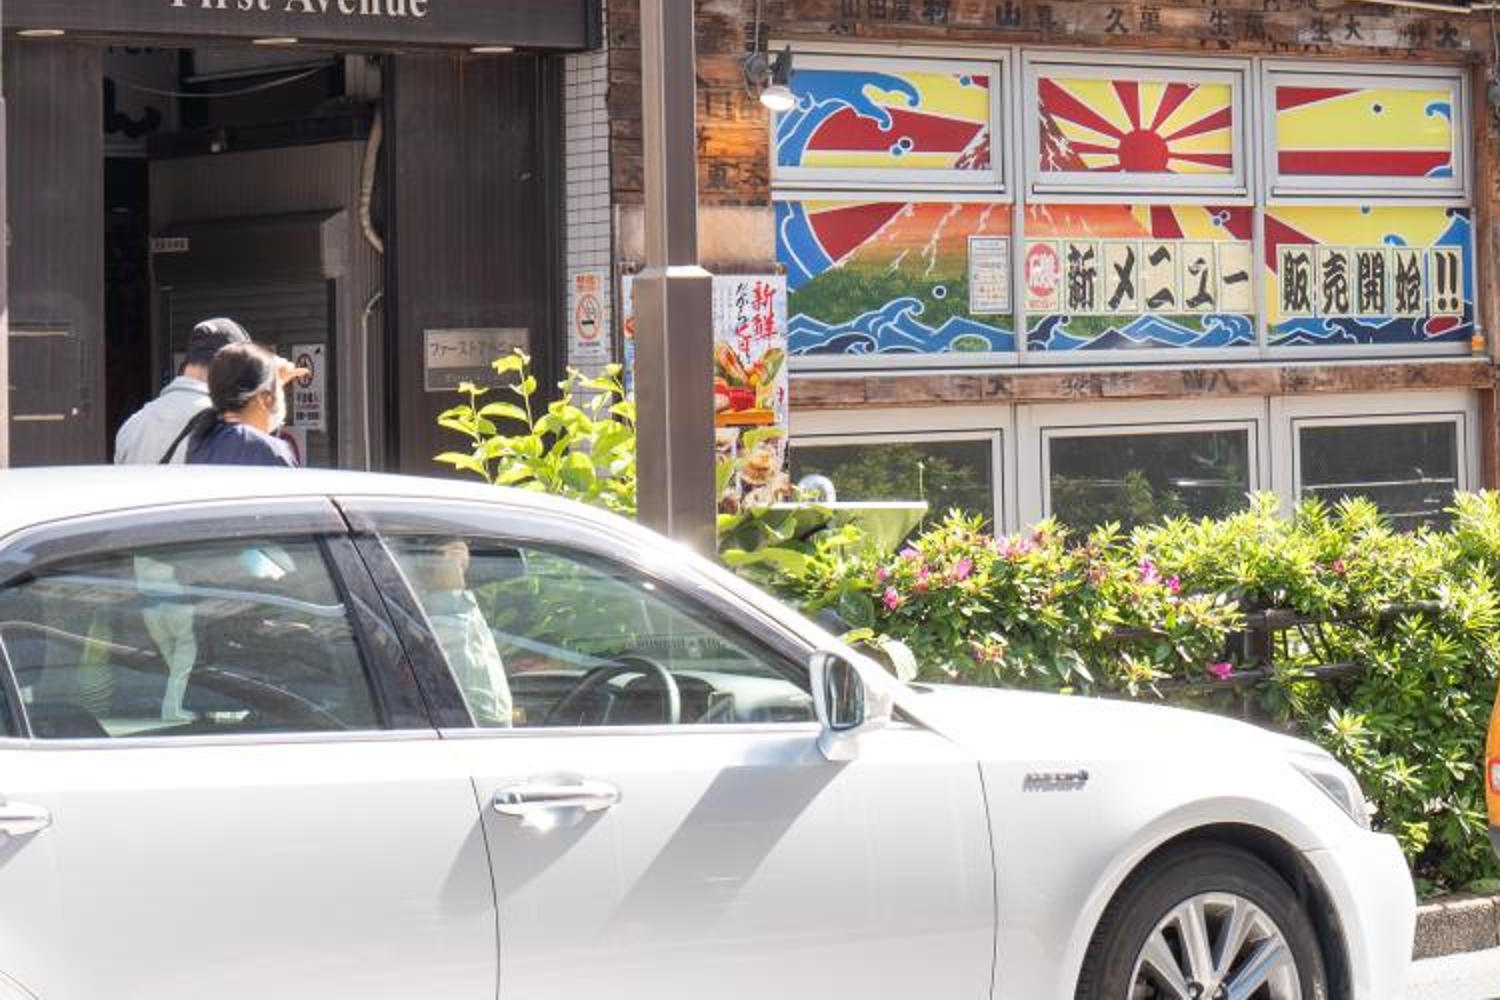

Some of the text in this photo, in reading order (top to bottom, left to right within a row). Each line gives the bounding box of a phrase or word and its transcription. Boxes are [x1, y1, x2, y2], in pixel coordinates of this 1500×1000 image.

[1066, 242, 1251, 310] 新メニュー
[1281, 247, 1459, 314] 販売開始!!
